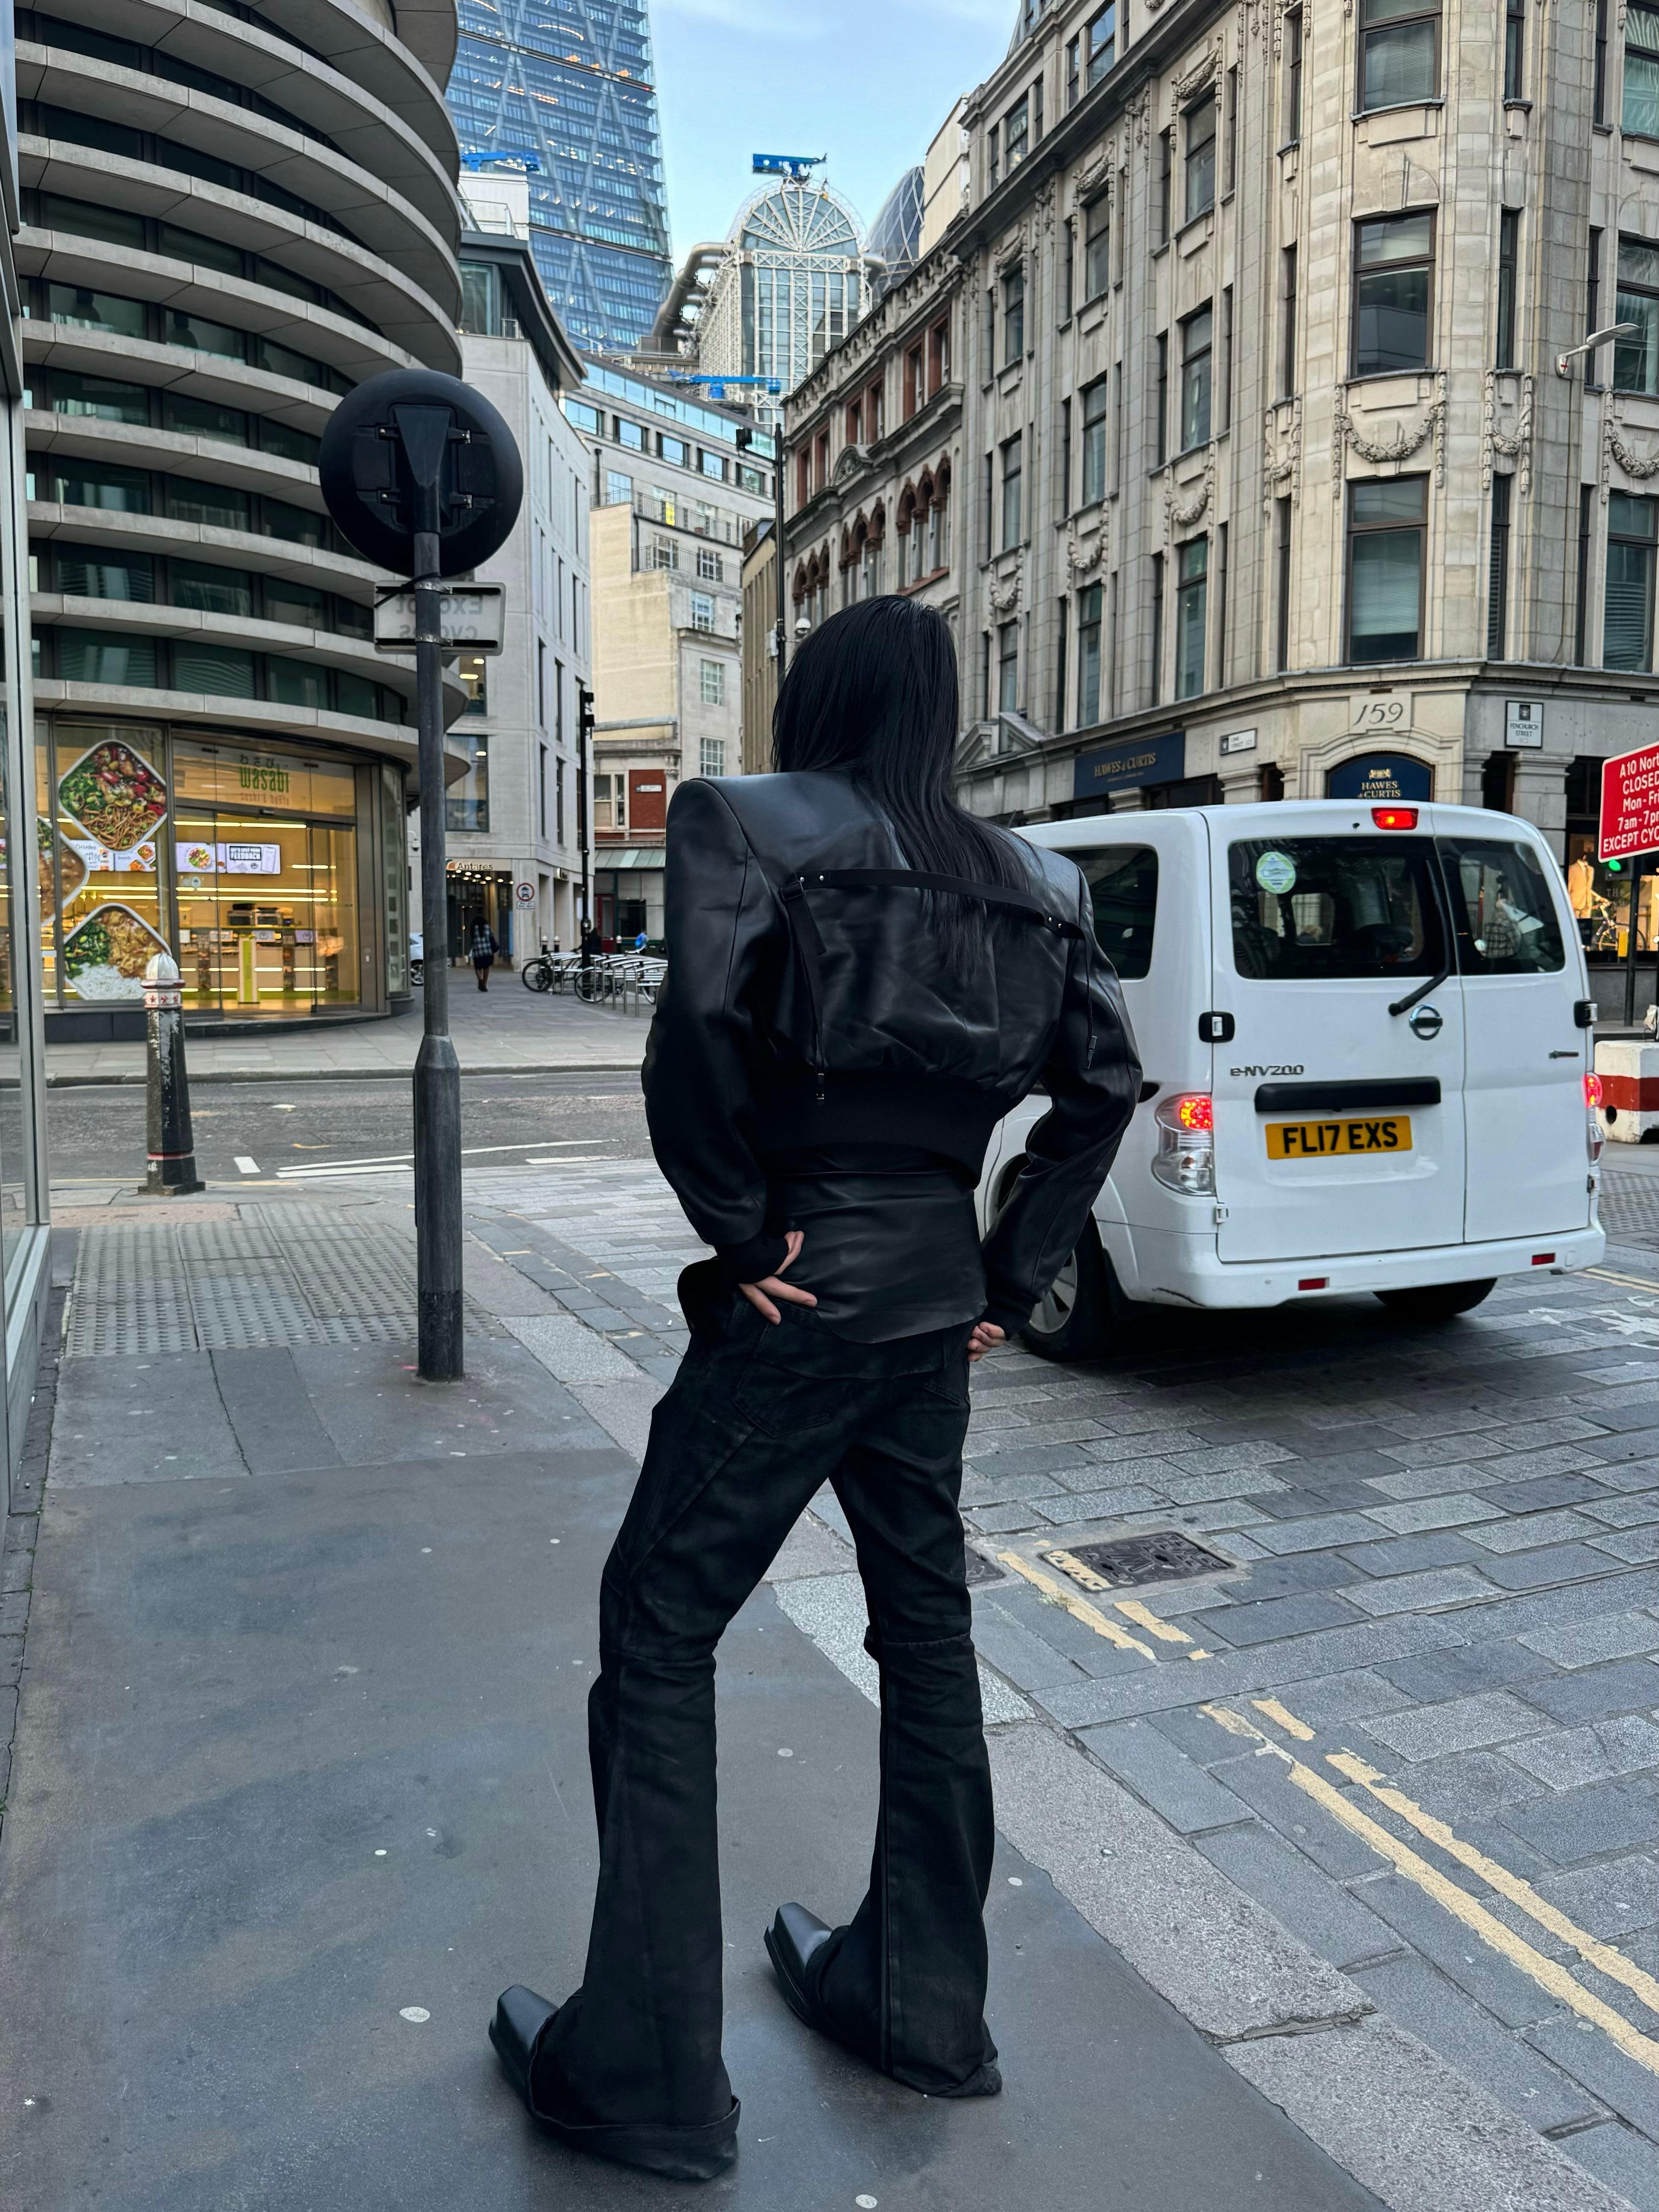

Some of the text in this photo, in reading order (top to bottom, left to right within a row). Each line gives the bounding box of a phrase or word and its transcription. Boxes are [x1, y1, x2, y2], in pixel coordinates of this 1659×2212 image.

[1352, 702, 1403, 726] 159
[1094, 761, 1120, 777] HAWES
[1127, 753, 1157, 770] CURTIS
[1619, 760, 1637, 778] A10
[239, 764, 289, 793] wasabi
[1362, 781, 1398, 790] HAWES
[1623, 770, 1659, 795] CLOSED
[1364, 790, 1401, 798] CURTIS
[1623, 797, 1642, 813] Mon
[1618, 817, 1637, 831] 7am
[1603, 825, 1659, 852] EXCEPT CYC
[1230, 1065, 1304, 1077] e-NV200
[1283, 1122, 1398, 1154] FL17 EXS
